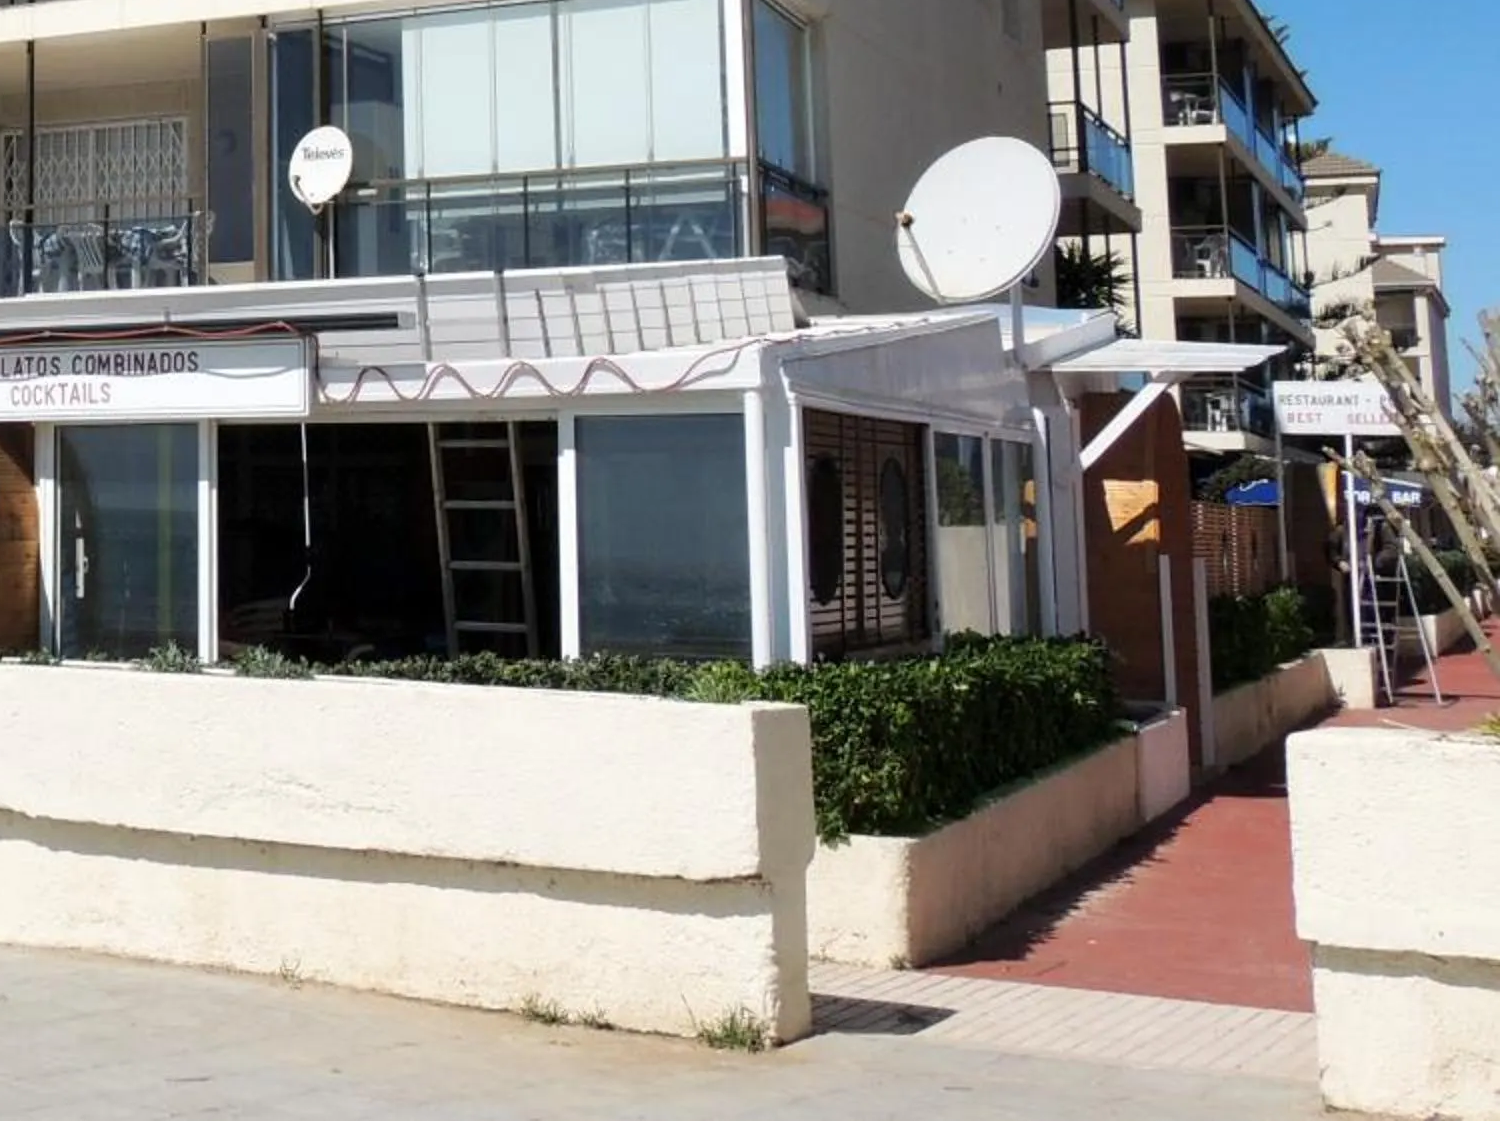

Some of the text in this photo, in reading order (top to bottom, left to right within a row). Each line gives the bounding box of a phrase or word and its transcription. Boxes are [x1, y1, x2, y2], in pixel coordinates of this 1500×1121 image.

[71, 351, 199, 375] COMBINADOS
[10, 382, 111, 407] COCKTAILS
[1279, 394, 1359, 406] RESTAURANT
